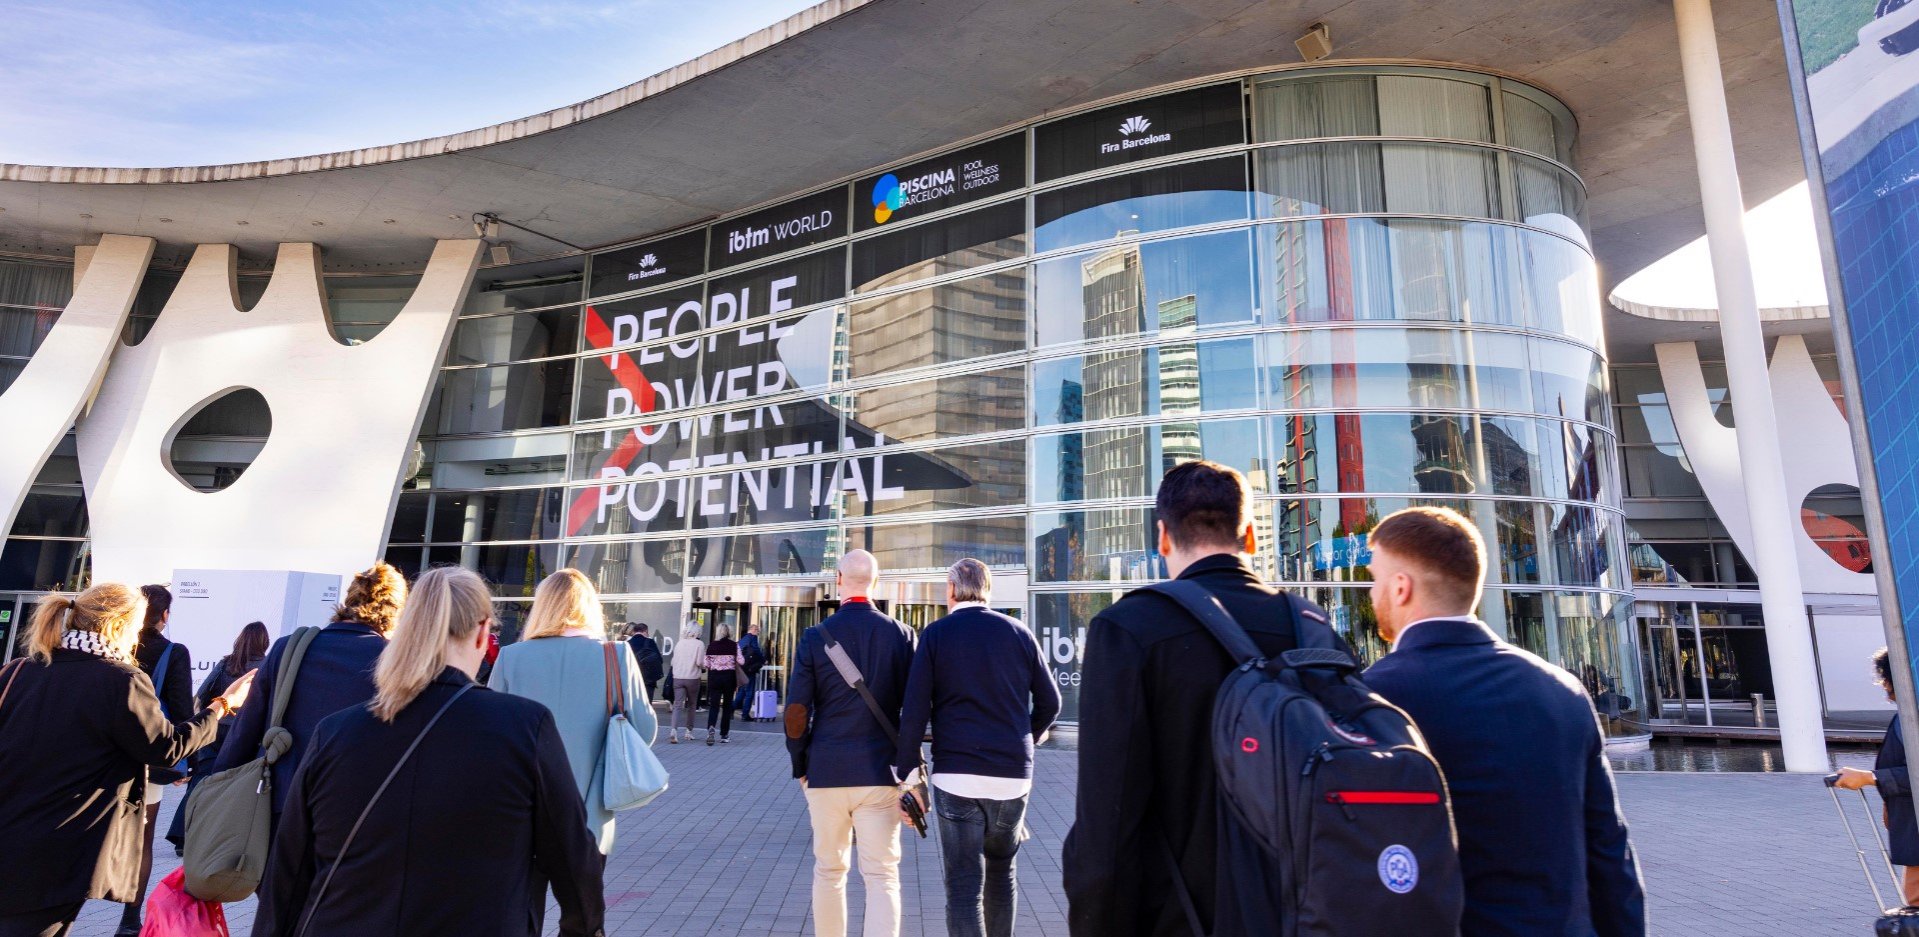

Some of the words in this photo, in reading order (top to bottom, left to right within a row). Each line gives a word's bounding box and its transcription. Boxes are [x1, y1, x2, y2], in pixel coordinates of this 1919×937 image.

[1101, 143, 1119, 153] Fira
[1122, 133, 1171, 149] Barcelona
[963, 160, 983, 172] POOL
[963, 165, 1000, 181] WELLNESS
[899, 168, 956, 196] PISCINA
[963, 174, 1000, 190] OUTDOOR
[899, 184, 956, 208] BARCELONA
[728, 226, 769, 254] ibtm
[774, 210, 832, 241] WORLD
[628, 272, 639, 281] Fira
[640, 267, 667, 279] Barcelona
[610, 276, 797, 370] PEOPLE
[603, 360, 787, 449] POWER
[597, 433, 905, 524] POTENTIAL
